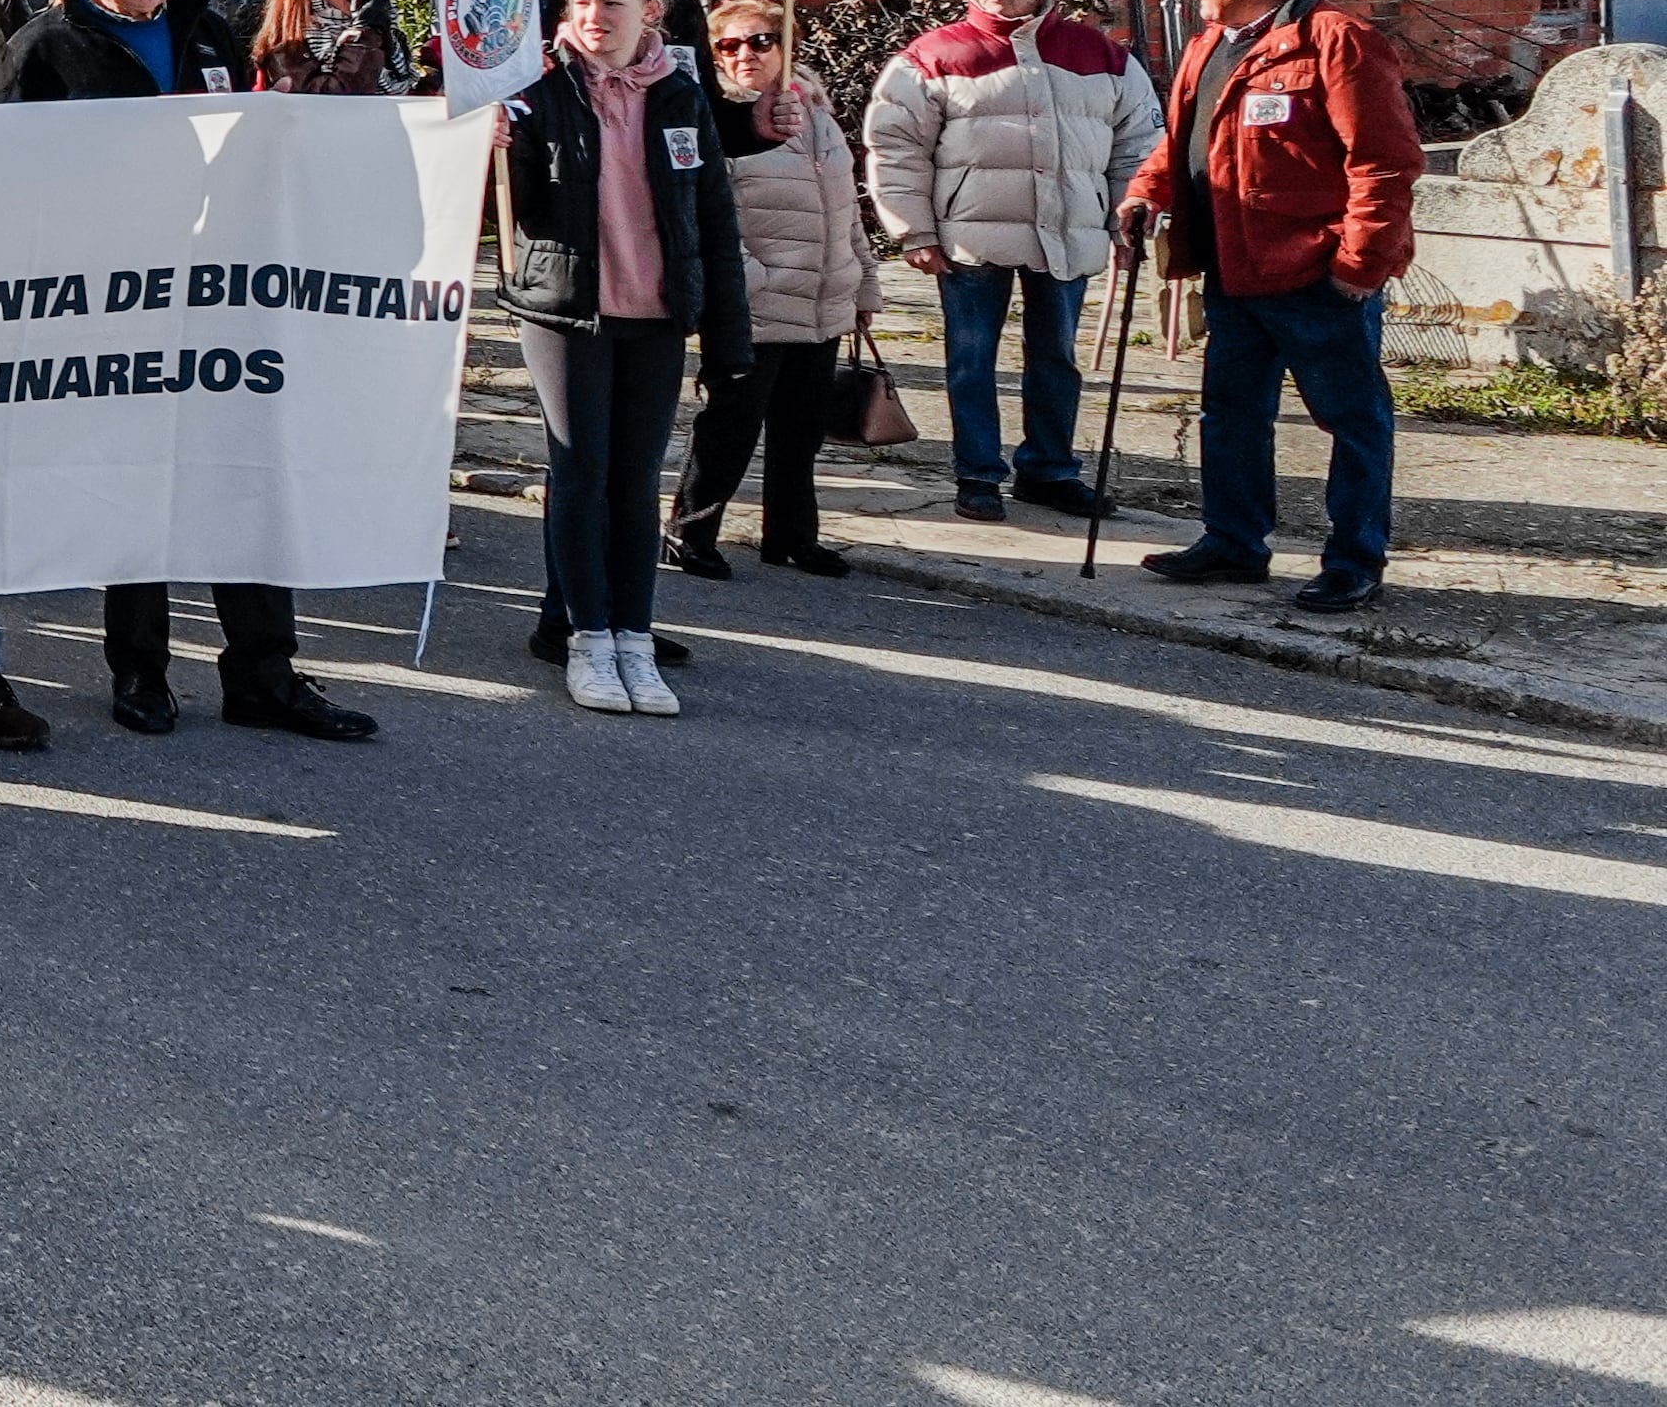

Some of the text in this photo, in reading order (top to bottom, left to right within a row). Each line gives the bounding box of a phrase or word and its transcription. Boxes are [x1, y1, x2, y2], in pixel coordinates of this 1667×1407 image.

[479, 29, 510, 53] NO
[103, 268, 173, 313] DE
[187, 263, 464, 322] BIOMETANO
